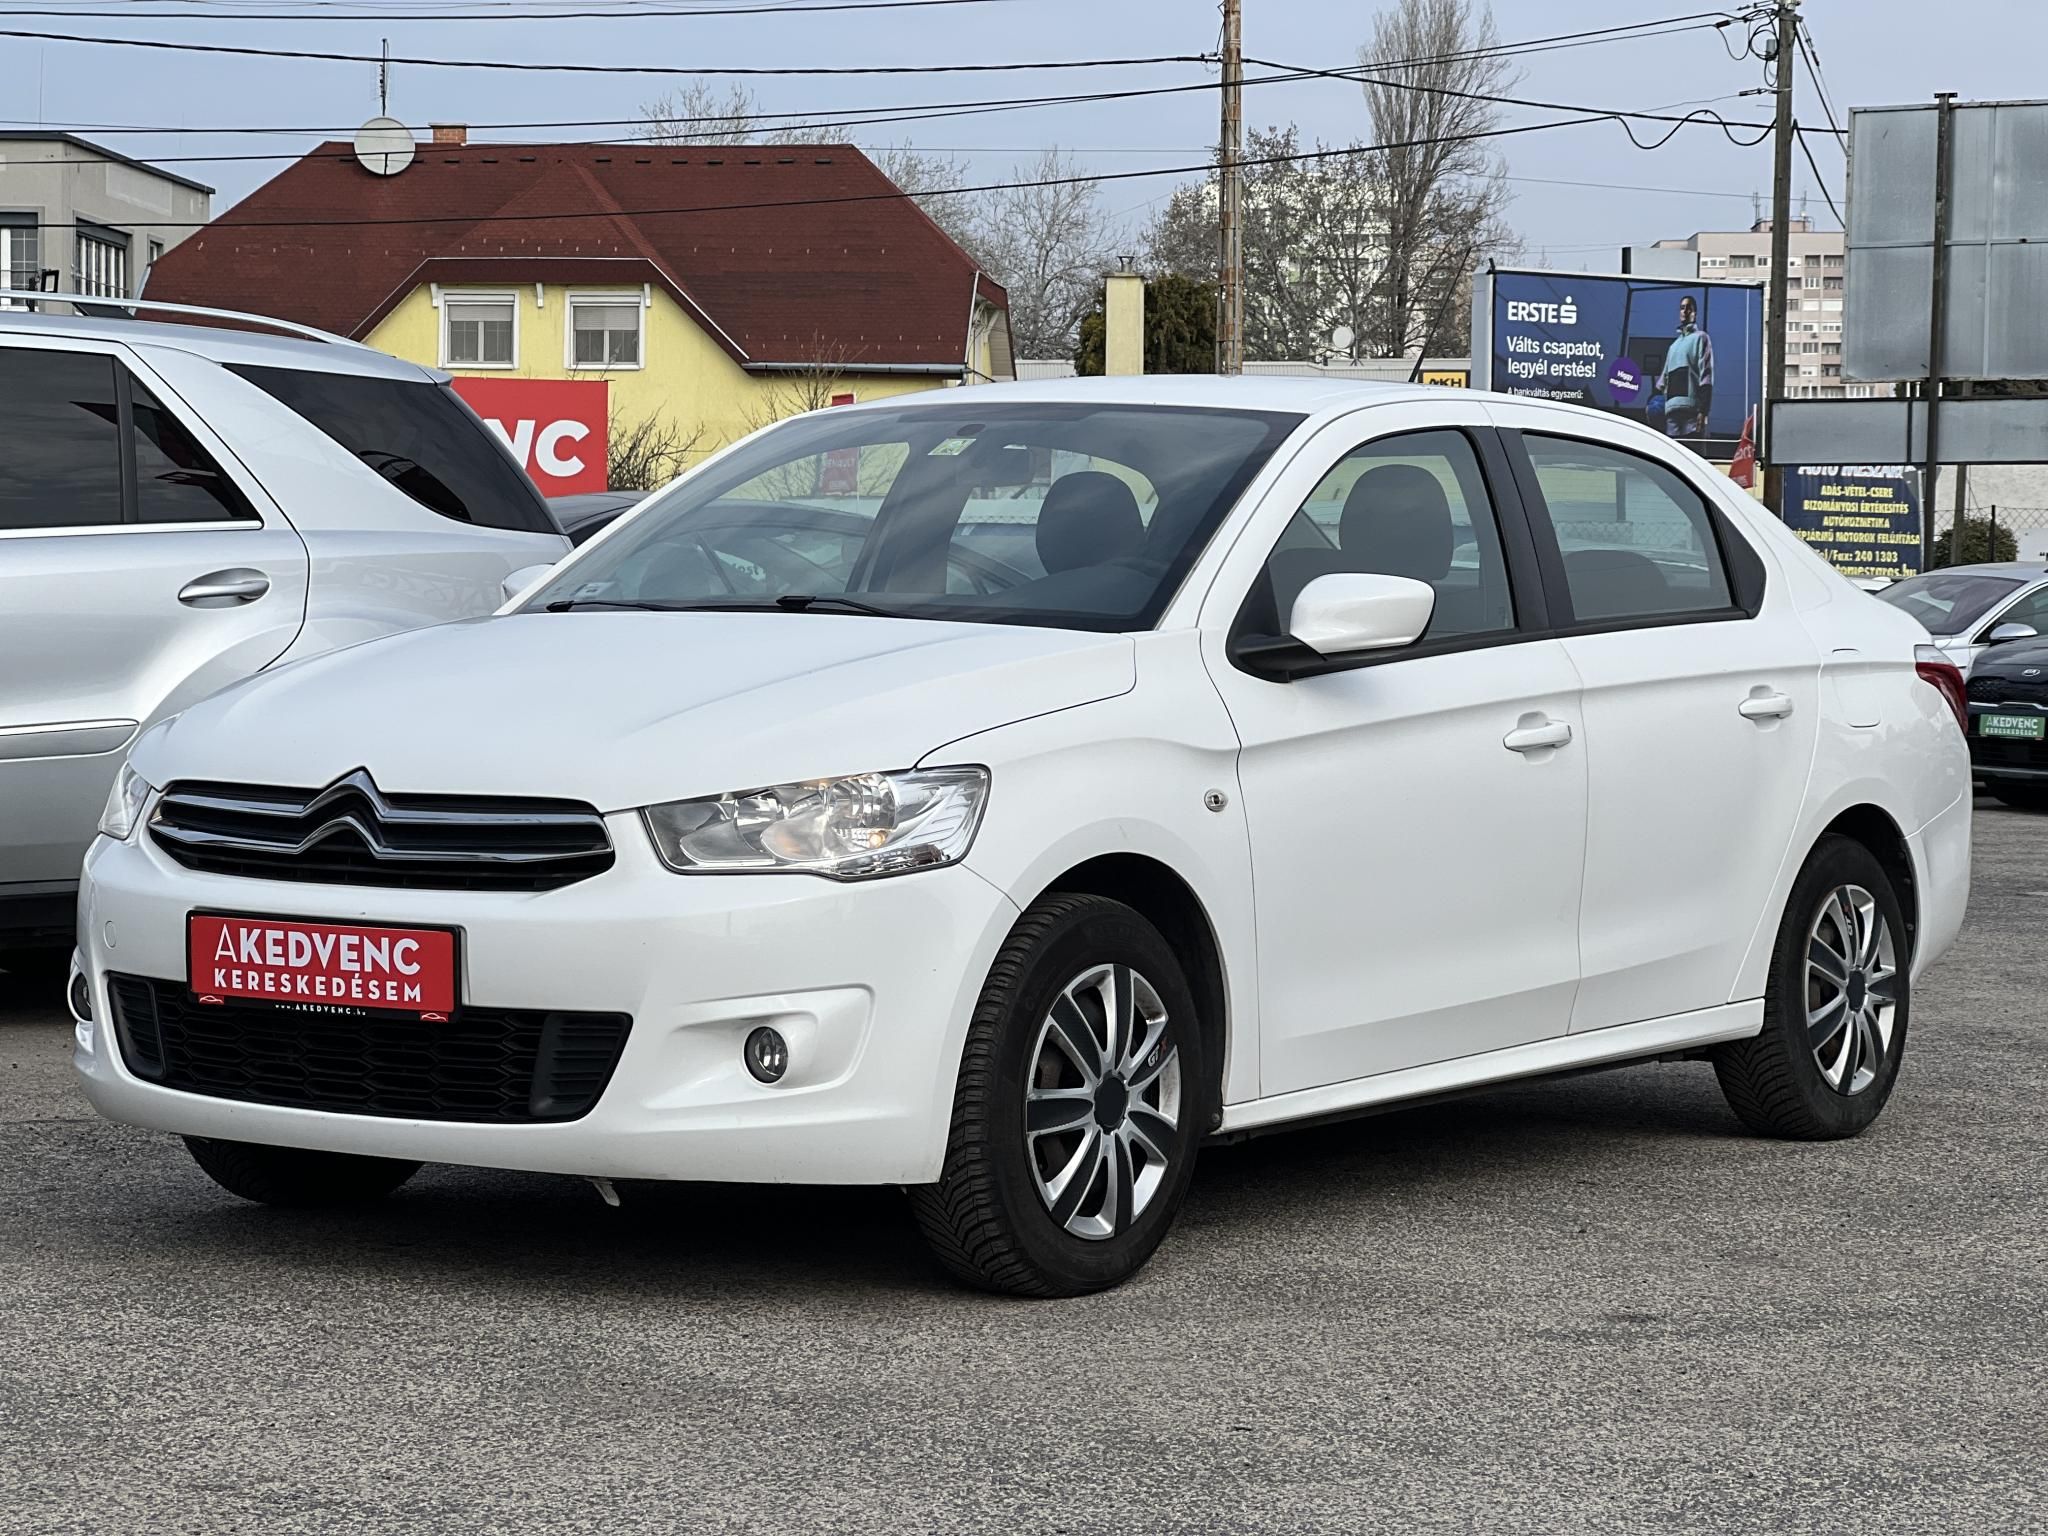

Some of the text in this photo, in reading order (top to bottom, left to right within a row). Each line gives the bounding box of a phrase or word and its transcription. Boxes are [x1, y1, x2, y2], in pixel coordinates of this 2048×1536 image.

[1507, 301, 1558, 323] ERSTE
[1506, 335, 1604, 360] Válts csapatot,
[1508, 358, 1596, 379] legyél erstés!
[1551, 389, 1584, 400] egyszerű:
[1855, 550, 1873, 562] 240
[1875, 550, 1898, 563] 1303
[1986, 716, 2039, 729] AKEDVENC
[214, 923, 421, 976] AKEDVENC
[214, 967, 421, 1003] KERESKEDÉSEM
